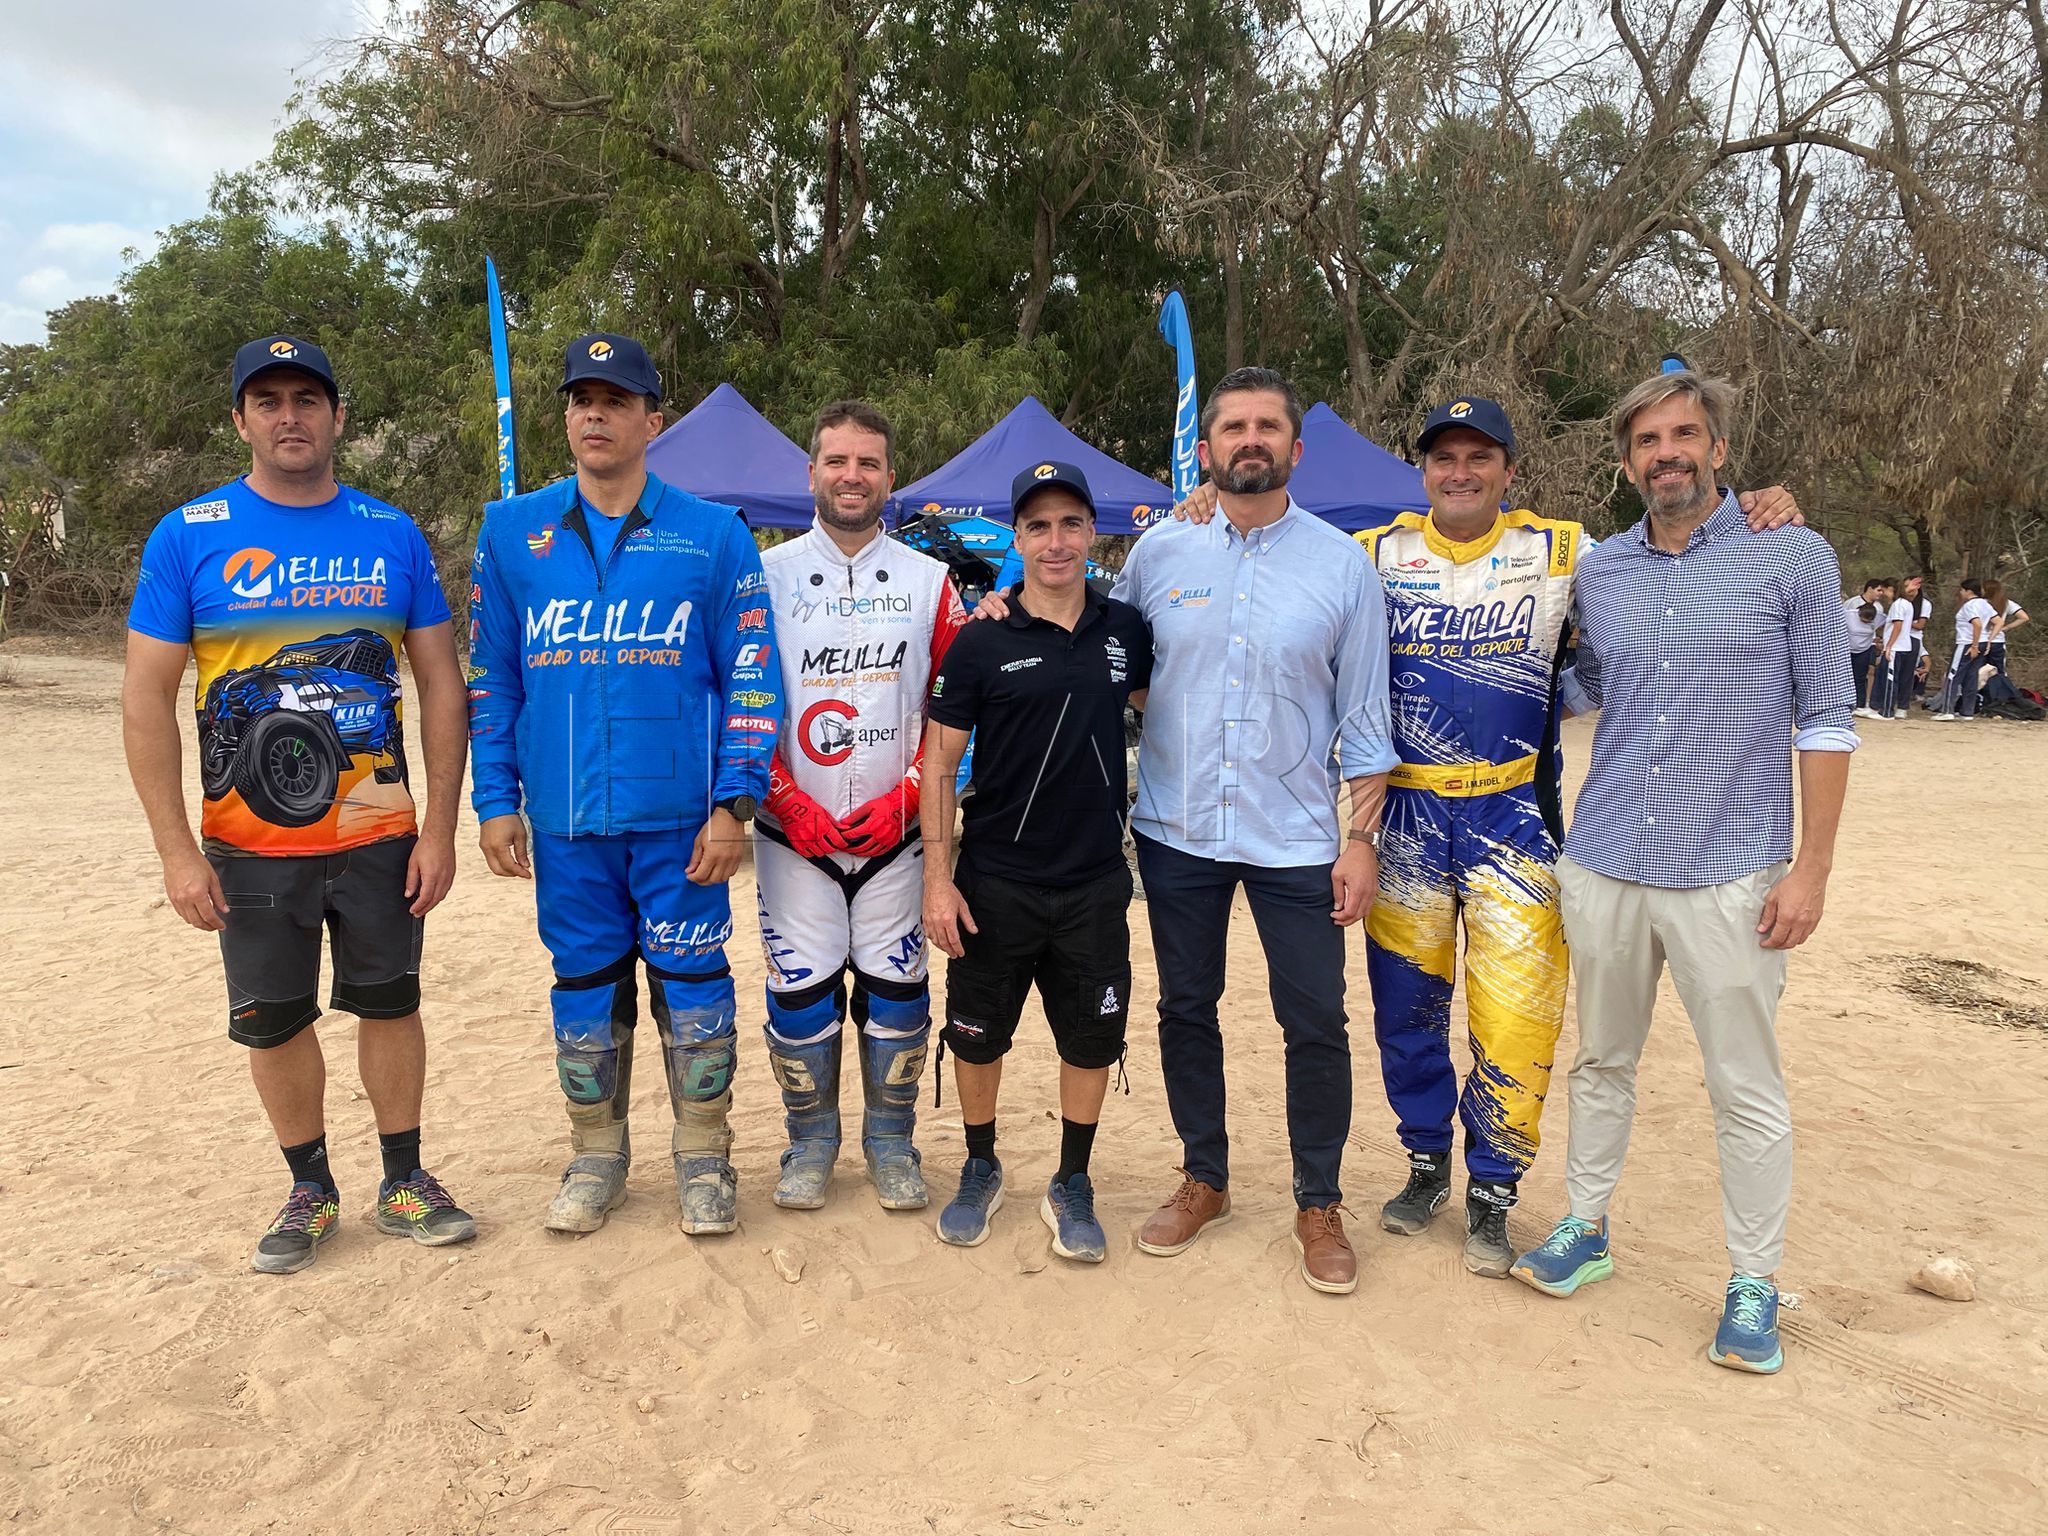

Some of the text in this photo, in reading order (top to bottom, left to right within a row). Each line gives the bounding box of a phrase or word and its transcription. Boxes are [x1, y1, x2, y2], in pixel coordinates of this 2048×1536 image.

[186, 506, 227, 516] MAROC
[660, 529, 678, 538] Una
[660, 537, 693, 545] historia
[659, 544, 709, 559] compartida
[1557, 529, 1568, 567] sparco
[1399, 581, 1441, 591] MELISUR
[290, 584, 389, 608] DEPORTE
[526, 598, 693, 647] MELILLA
[1391, 596, 1534, 642] MELILLA
[1391, 636, 1526, 658] CIUDAD DEL DEPORTE
[527, 648, 682, 669] CIUDAD DEL DEPORTE
[800, 641, 907, 676] MELILLA
[732, 671, 763, 681] Grupo 4
[1403, 692, 1430, 703] Tirado
[335, 704, 376, 720] KING
[728, 718, 774, 731] MOTUL
[646, 914, 732, 946] MELILLA
